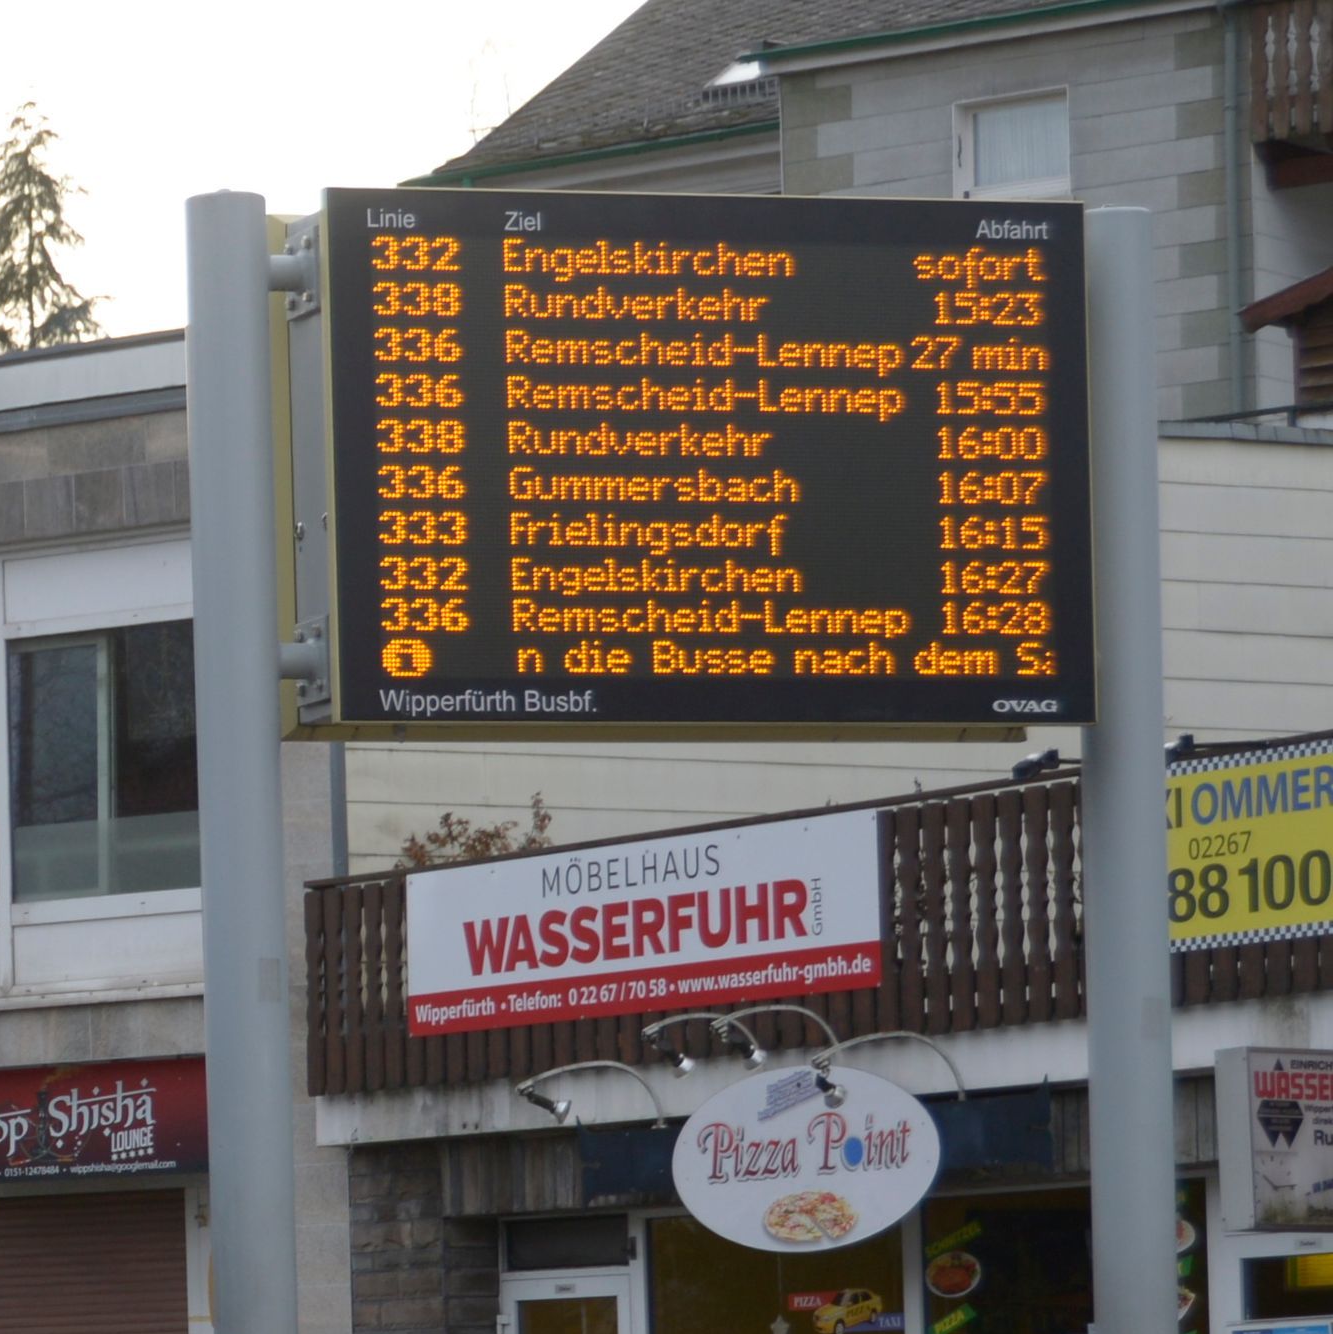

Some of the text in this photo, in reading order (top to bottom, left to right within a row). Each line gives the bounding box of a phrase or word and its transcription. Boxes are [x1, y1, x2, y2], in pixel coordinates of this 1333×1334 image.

[367, 208, 1049, 240] Linie Ziel Abfahrt
[371, 236, 1047, 289] 332 Engelskirchen sofort
[373, 282, 1045, 326] 338 Rundverkehr 15:23
[374, 328, 1051, 377] 336 Remscheid-Lennep 27 min
[375, 373, 1047, 422] 336 Remscheid-Lennep 15:55
[376, 419, 1048, 460] 338 Rundverkehr 16:00
[377, 465, 1050, 505] 336 Gummersbach 16:07
[378, 511, 1051, 556] 333 Frielingsdorf 16:15
[379, 556, 1051, 596] 332 Engelskirchen 16:27
[380, 597, 1052, 639] 336 Remscheid-Lennep 16:28
[517, 647, 544, 674] n
[563, 640, 633, 675] die
[652, 640, 776, 675] Busse
[793, 641, 896, 675] nach
[913, 641, 1001, 676] dem
[379, 688, 598, 717] Wipperfürth Busbf.
[992, 699, 1059, 713] OVAG
[1190, 764, 1333, 826] OMMER
[1188, 830, 1252, 861] 02267
[541, 844, 721, 898] MÖBELHAUS
[1167, 849, 1333, 923] 88 100
[462, 878, 809, 977] WASSERFUHR
[811, 876, 824, 937] GmbH
[415, 998, 496, 1026] Wipperfürth
[507, 991, 563, 1014] Telefon:
[677, 953, 872, 995] www.wasserfuhr-gmbh.de
[1253, 1071, 1333, 1101] WASSE
[1290, 1059, 1333, 1071] EINRICH
[48, 1079, 157, 1138] Shisha
[110, 1125, 154, 1153] LOUNGE
[697, 1111, 912, 1184] Pizza Point
[792, 1296, 822, 1309] PIZZA
[879, 1316, 902, 1329] TAXI
